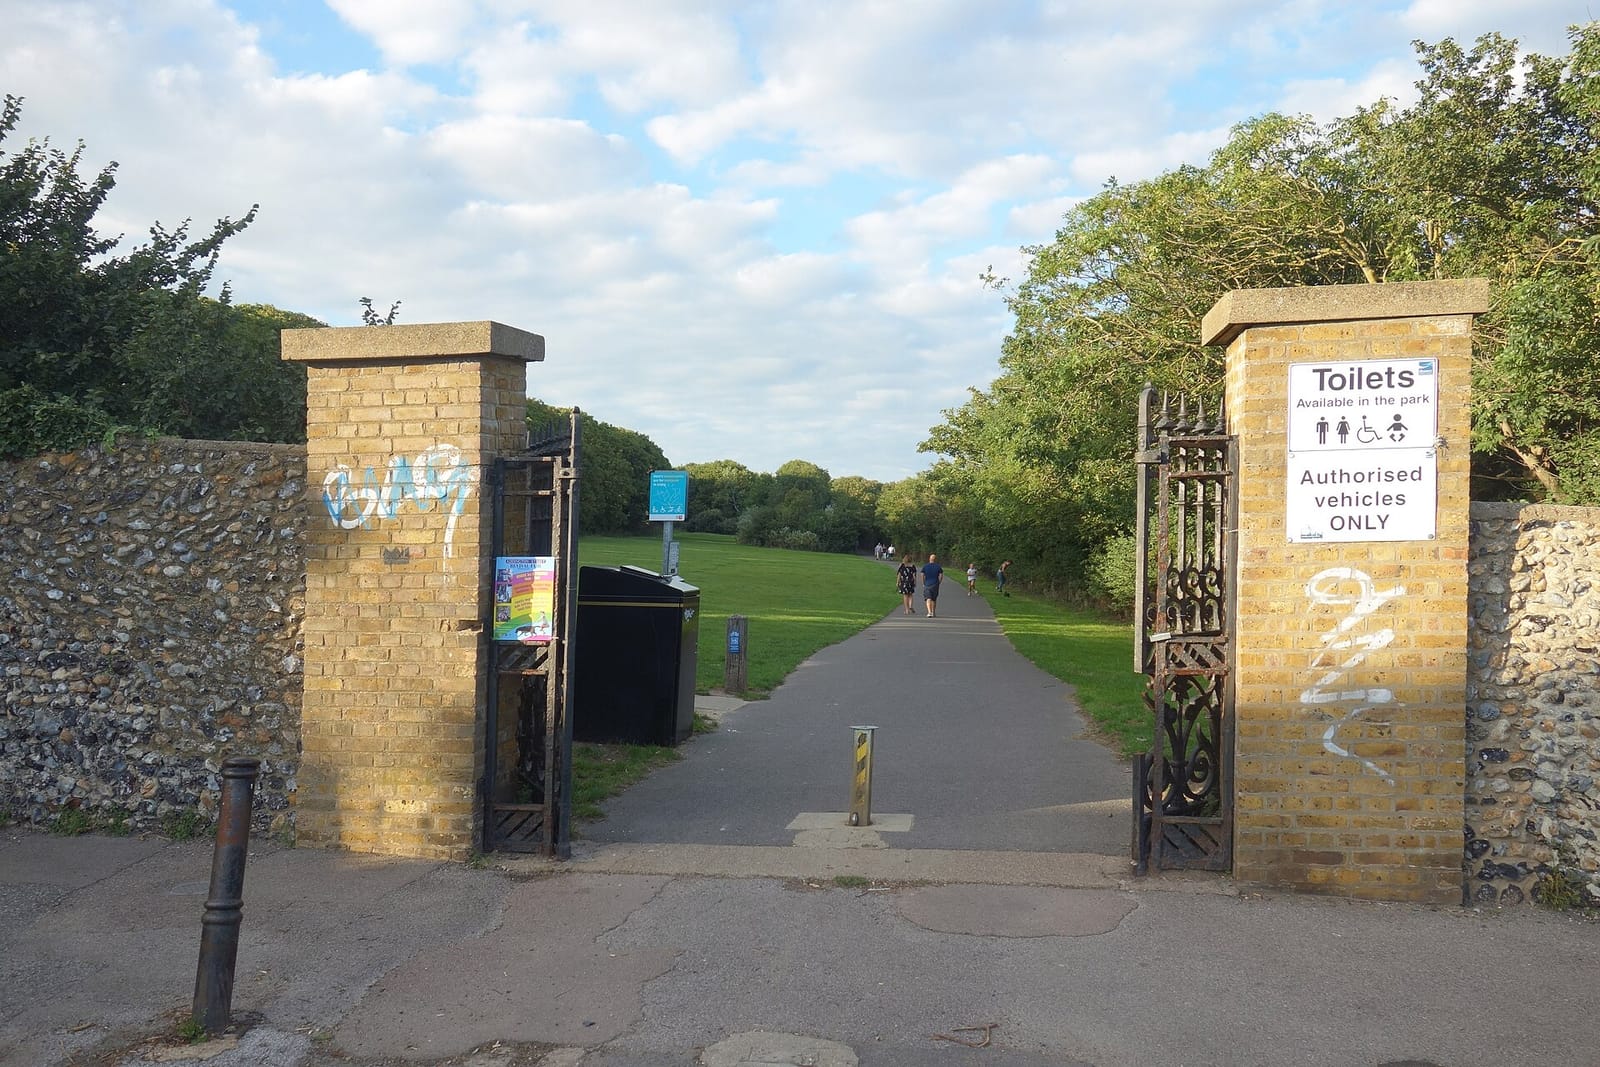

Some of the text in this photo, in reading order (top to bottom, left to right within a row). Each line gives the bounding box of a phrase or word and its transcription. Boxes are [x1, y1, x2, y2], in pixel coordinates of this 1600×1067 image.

[1312, 367, 1414, 391] Toilets
[1297, 394, 1429, 408] Available in the park
[1300, 467, 1422, 485] Authorised
[1315, 491, 1406, 507] vehicles
[1330, 515, 1389, 530] ONLY
